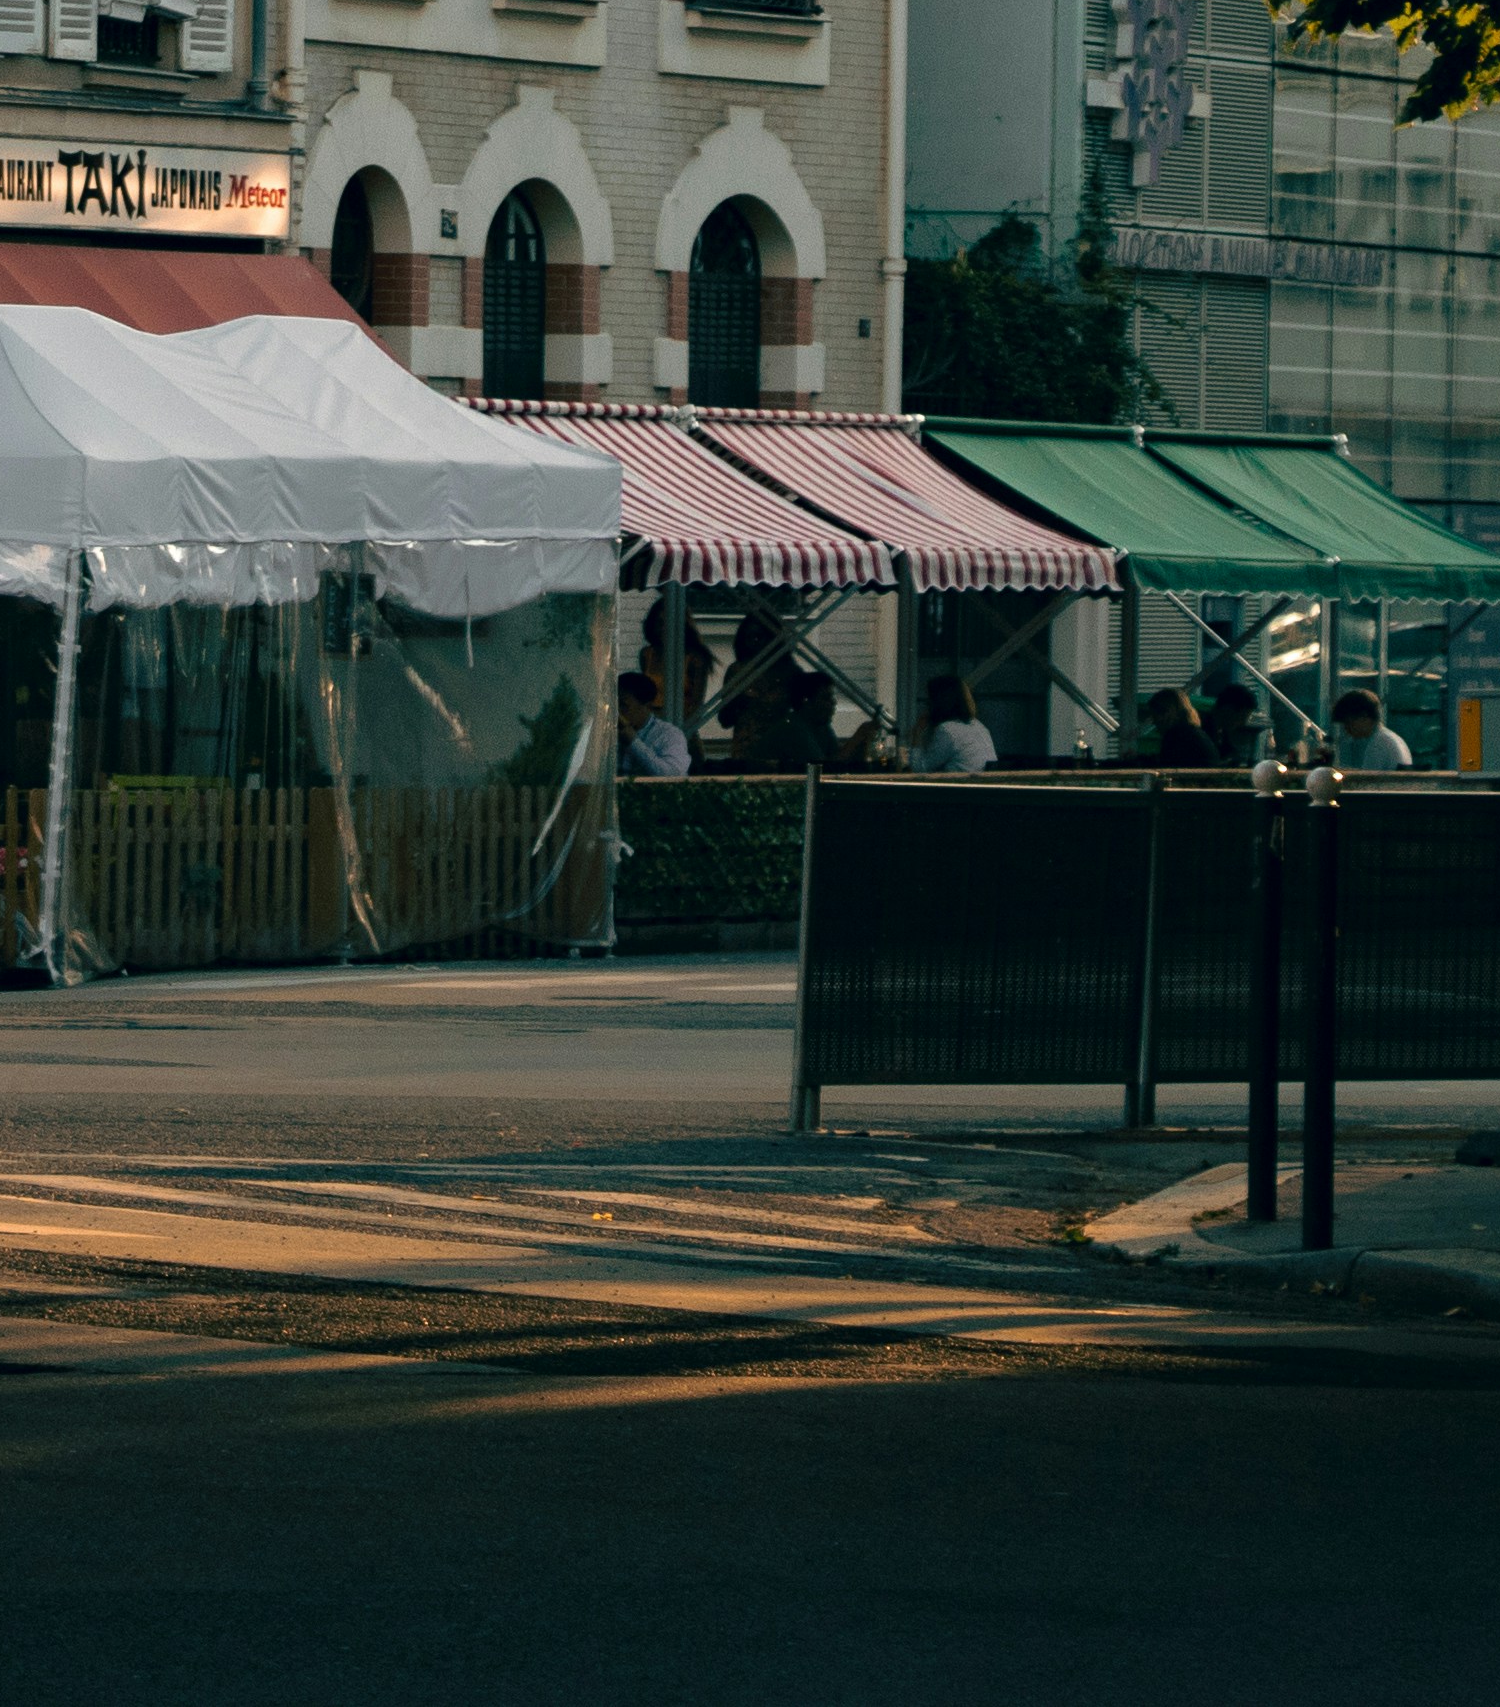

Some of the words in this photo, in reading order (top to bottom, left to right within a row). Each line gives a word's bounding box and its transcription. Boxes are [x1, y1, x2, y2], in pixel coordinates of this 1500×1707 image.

[58, 148, 148, 220] TAKI
[151, 166, 222, 211] JAPONAIS
[225, 174, 288, 209] Meteor
